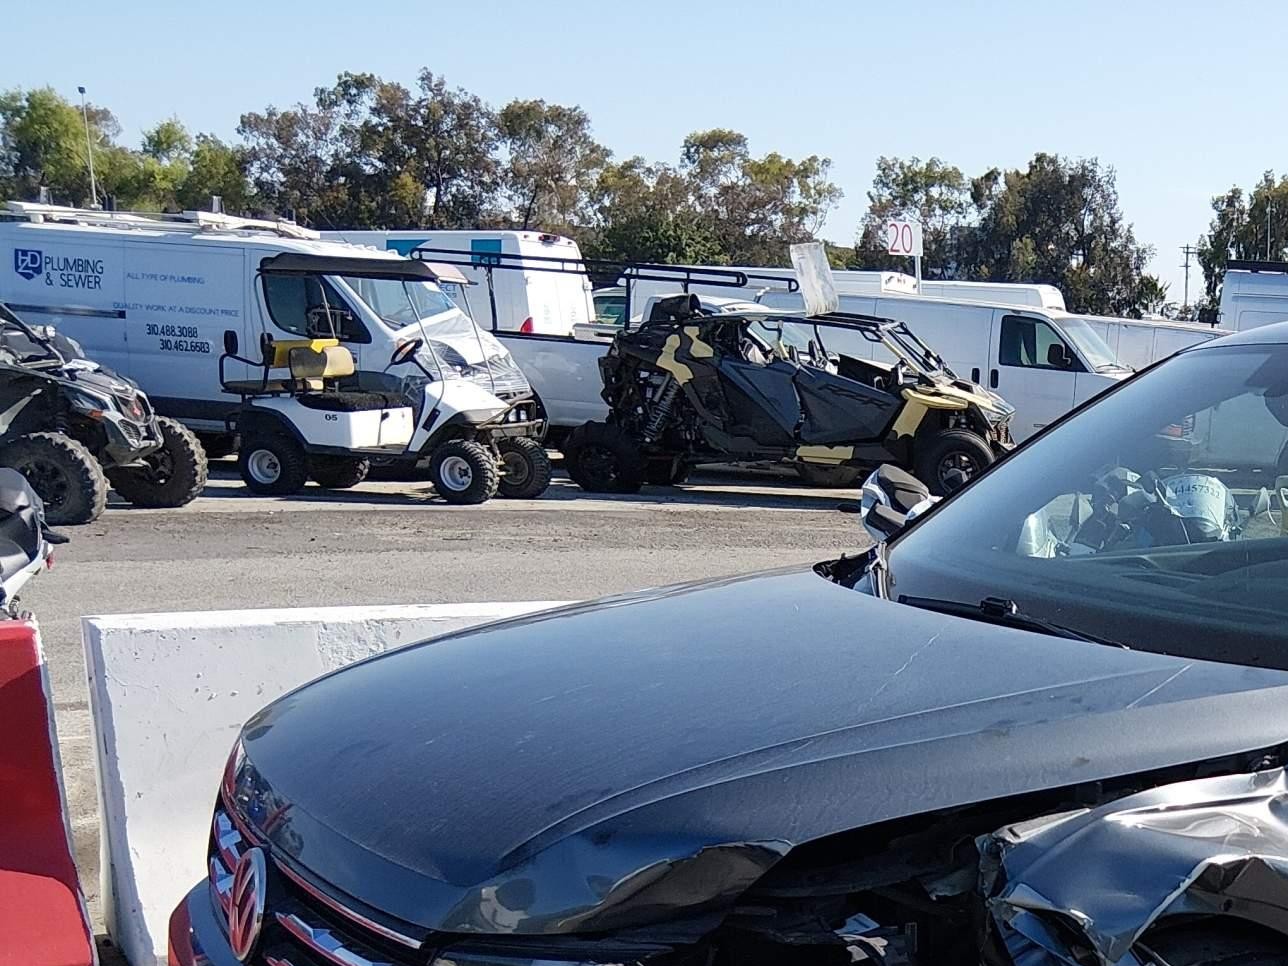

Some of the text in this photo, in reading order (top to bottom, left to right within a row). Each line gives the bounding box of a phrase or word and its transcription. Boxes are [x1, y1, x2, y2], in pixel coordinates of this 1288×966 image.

[889, 223, 912, 253] 20
[44, 256, 104, 275] PLUMBING
[45, 271, 102, 289] & SEWER
[126, 272, 139, 280] ALL
[141, 272, 158, 281] TYPE
[113, 301, 143, 311] QUALITY
[145, 304, 167, 312] WORK
[168, 305, 177, 313] AT
[184, 306, 220, 316] DISCOUNT
[220, 308, 240, 317] PRICE
